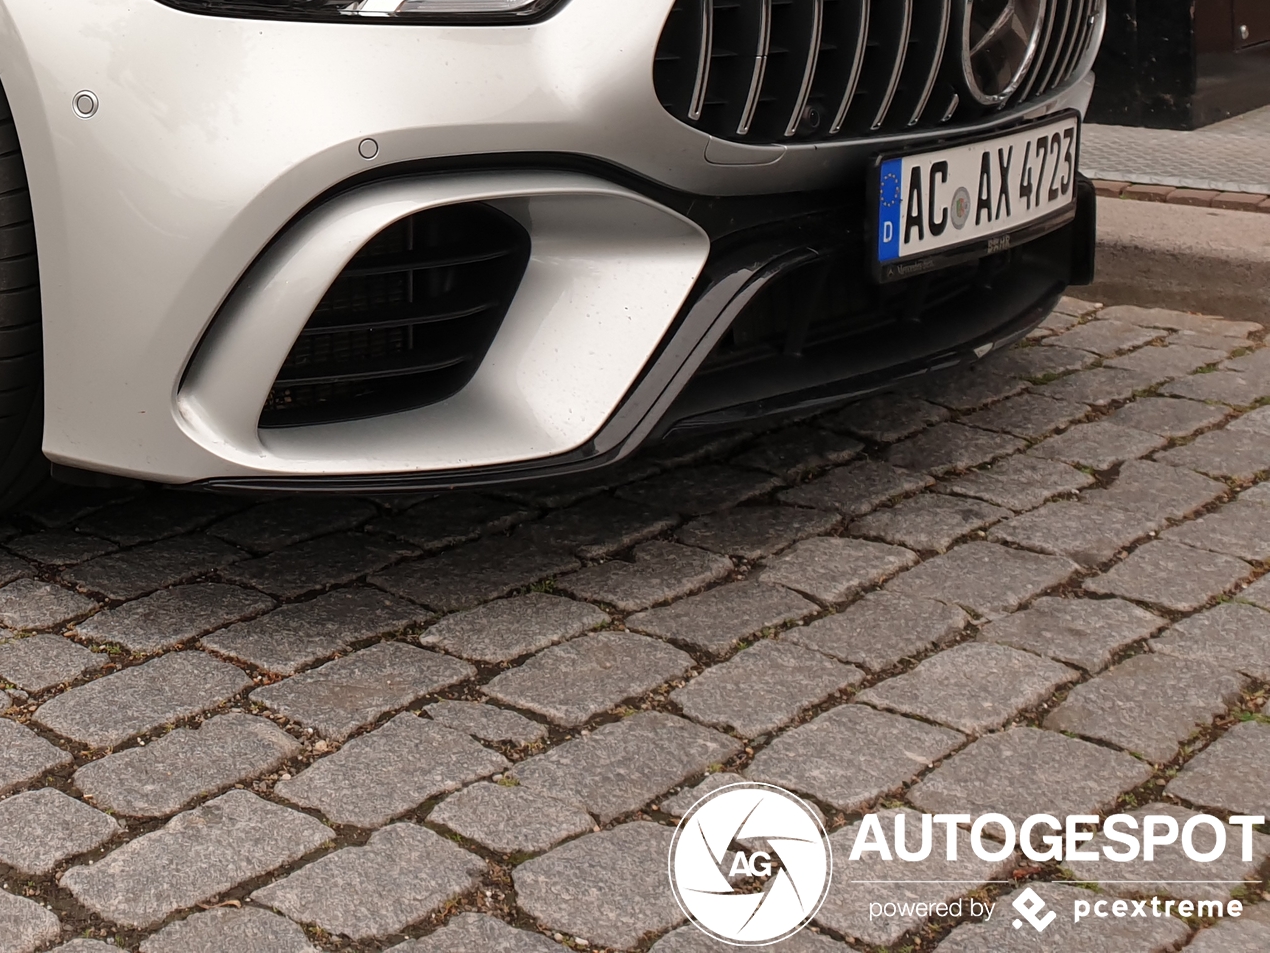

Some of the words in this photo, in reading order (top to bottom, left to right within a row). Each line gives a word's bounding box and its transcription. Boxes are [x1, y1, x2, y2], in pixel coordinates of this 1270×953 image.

[904, 160, 948, 245] AC
[975, 145, 1014, 226] AX
[1019, 127, 1075, 210] 4723
[883, 221, 893, 243] D
